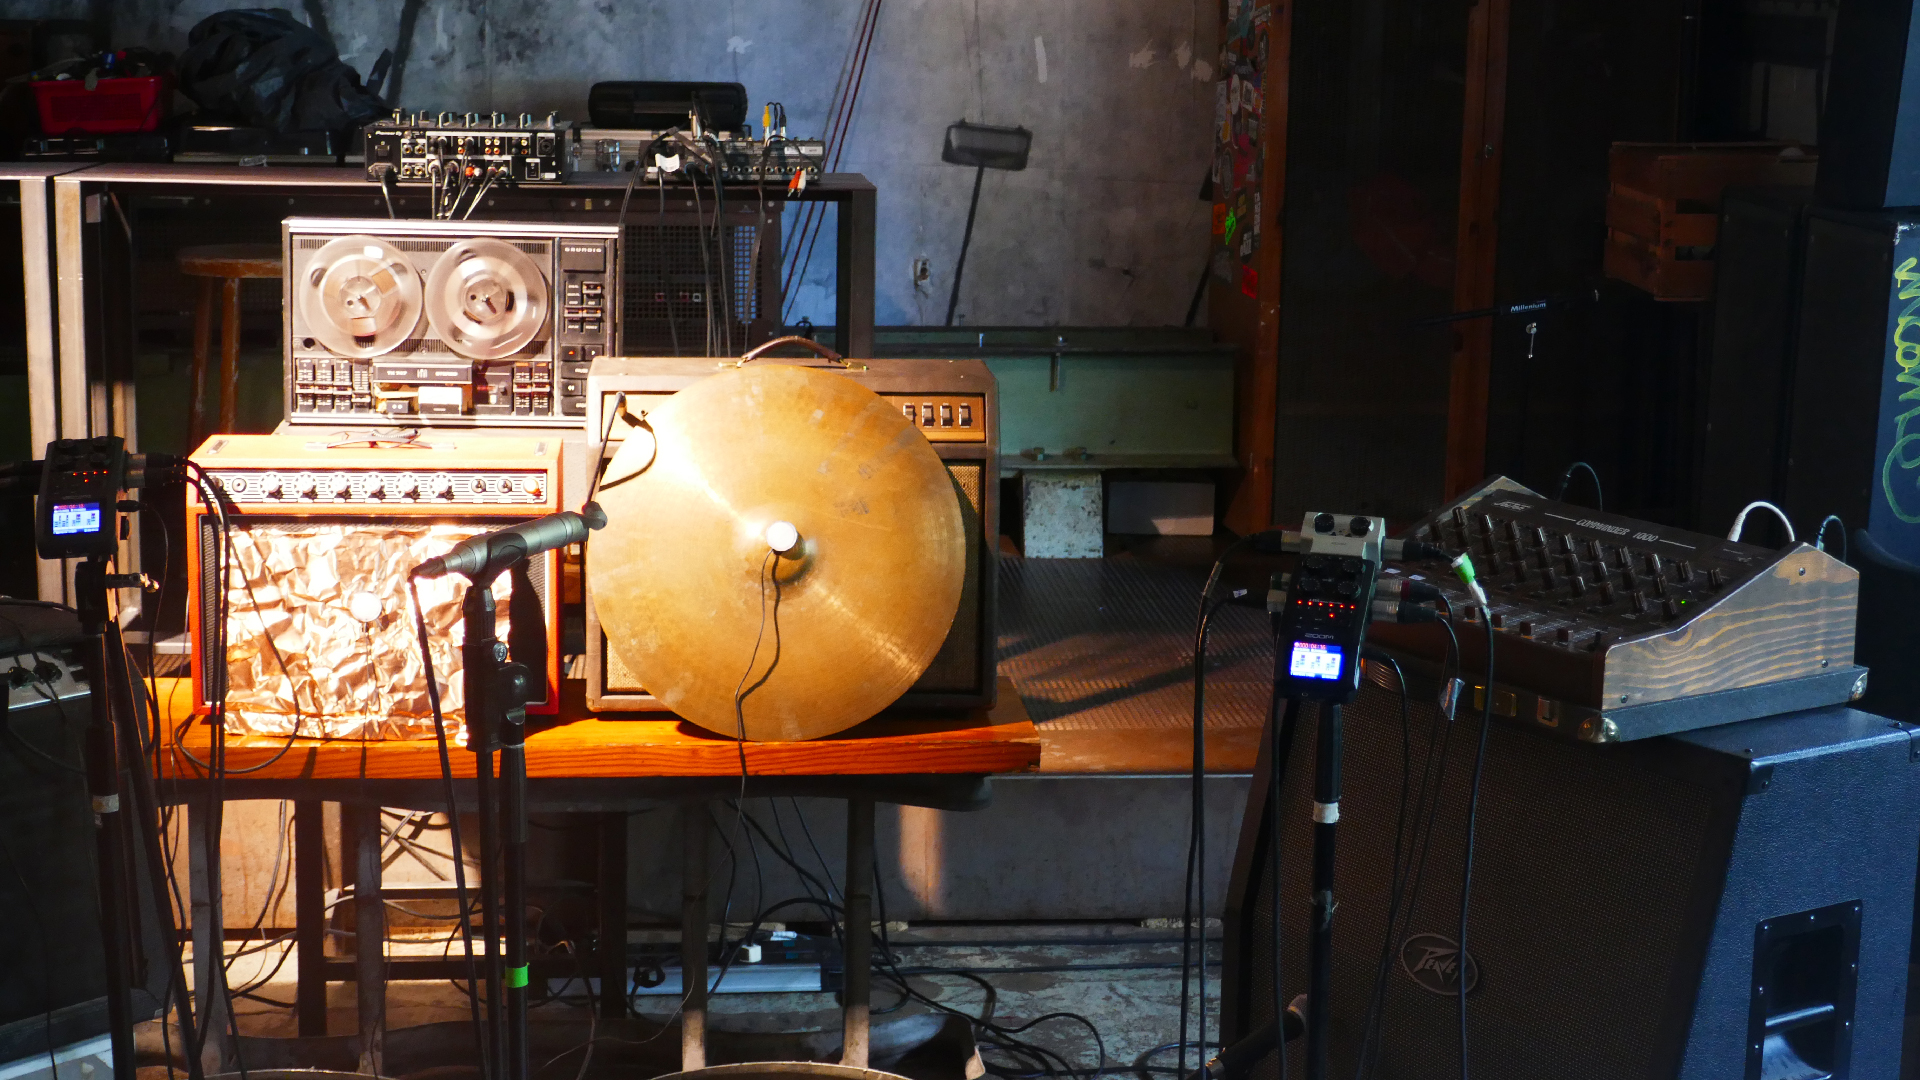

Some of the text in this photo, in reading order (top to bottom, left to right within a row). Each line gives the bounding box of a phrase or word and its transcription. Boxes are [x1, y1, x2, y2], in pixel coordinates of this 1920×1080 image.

[1511, 302, 1547, 312] Millenium
[1575, 518, 1660, 543] COMMANDER 1000
